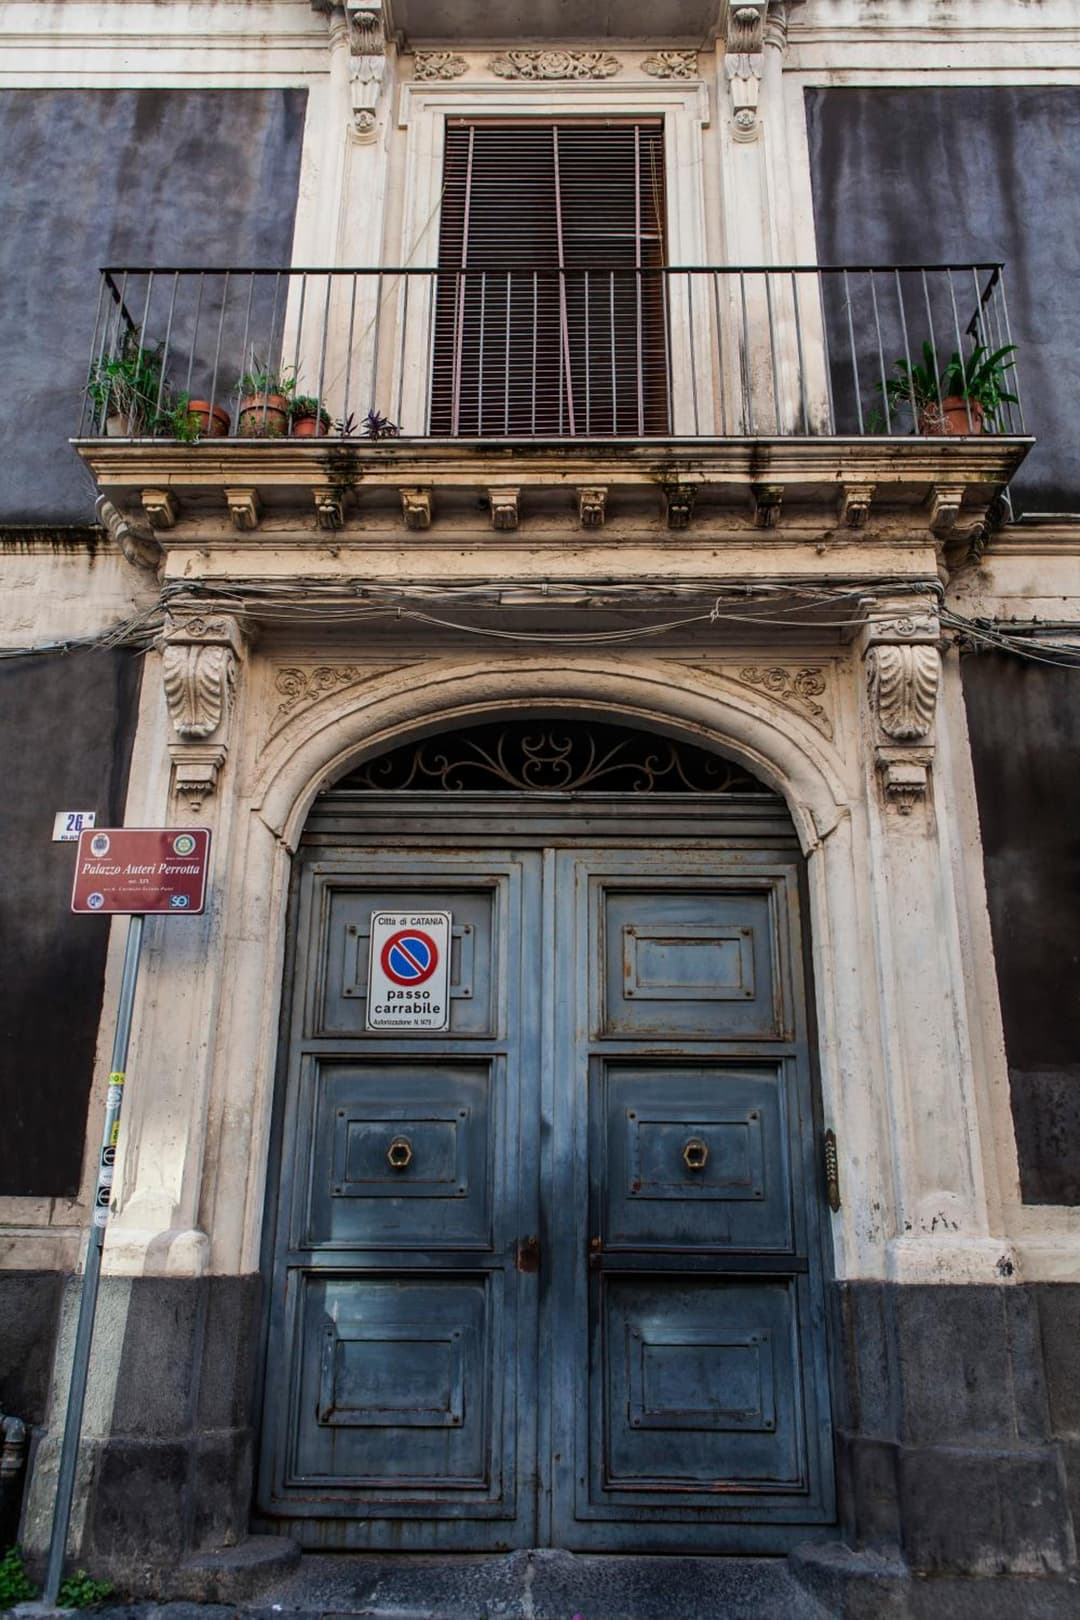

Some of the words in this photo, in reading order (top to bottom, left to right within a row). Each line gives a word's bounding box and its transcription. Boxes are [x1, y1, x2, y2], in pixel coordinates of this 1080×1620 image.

[66, 814, 83, 831] 26
[82, 863, 121, 875] Palazzo
[122, 863, 156, 875] Auteri
[157, 863, 200, 875] Perrotta
[399, 917, 407, 926] di
[410, 917, 443, 926] CATANIA
[387, 990, 430, 1000] passo
[374, 1002, 440, 1014] carrabile
